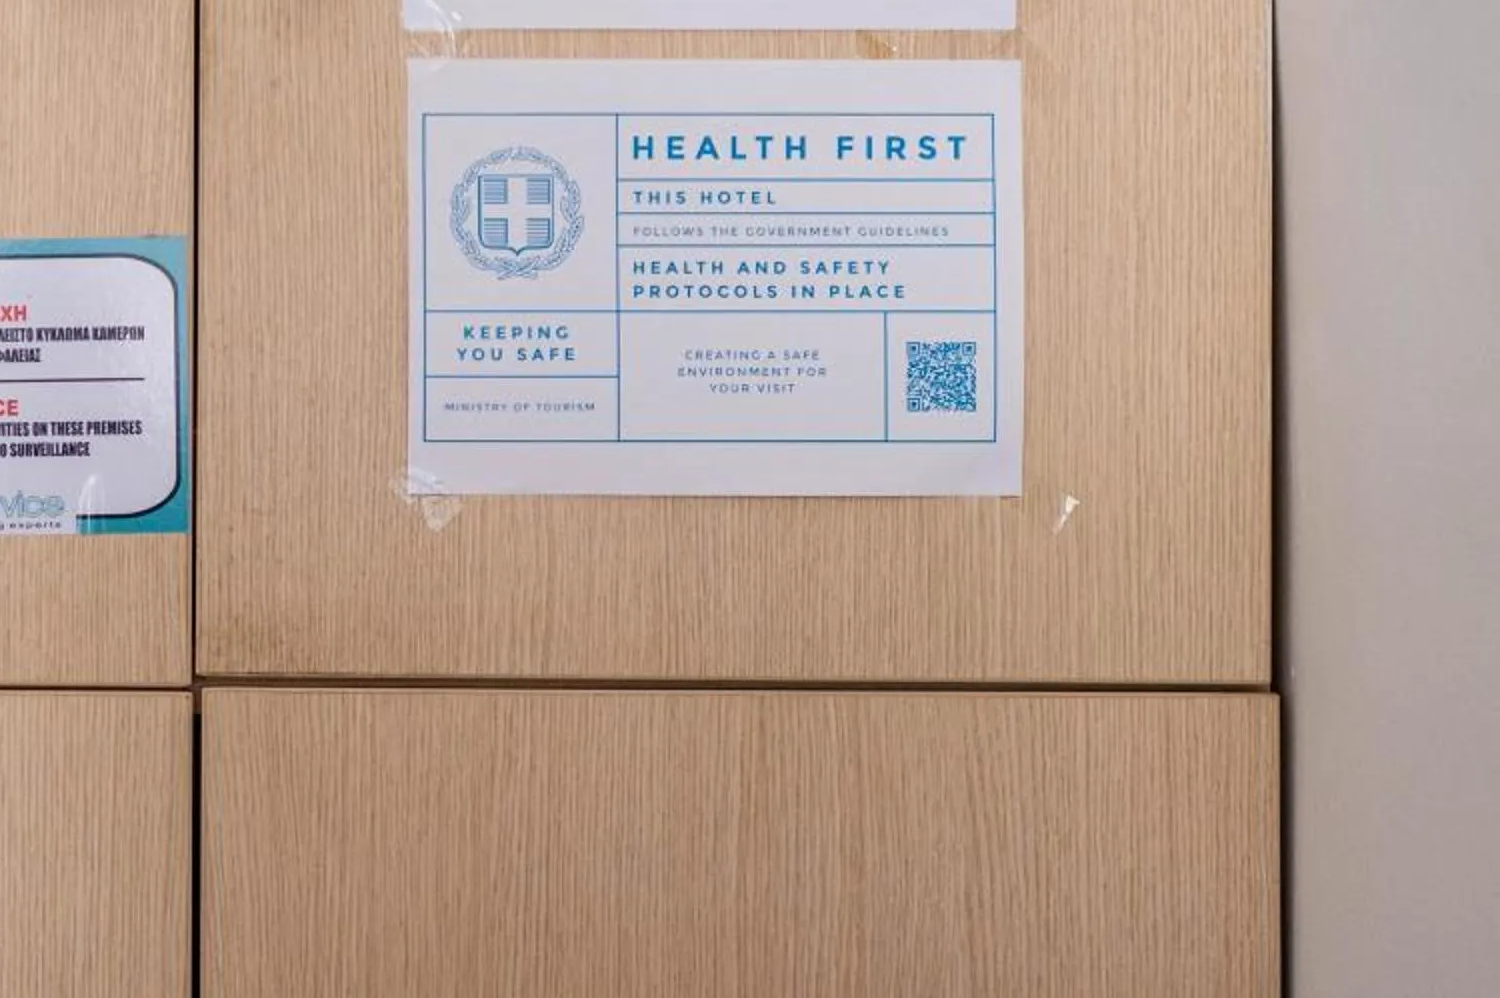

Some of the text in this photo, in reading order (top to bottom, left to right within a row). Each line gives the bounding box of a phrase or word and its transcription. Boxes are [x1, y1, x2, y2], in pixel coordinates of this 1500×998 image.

[632, 135, 967, 160] HEALTH FIRST
[633, 190, 777, 205] THIS HOTEL
[632, 225, 950, 238] FOLLOWS THE GOVERNMENT GUIDELINES
[632, 260, 890, 275] HEALTH AND SAFETY
[632, 284, 905, 299] PROTOCOLS IN PLACE
[463, 325, 569, 340] KEEPING
[456, 347, 577, 362] YOU SAFE
[683, 349, 821, 361] CREATING A SAFE
[677, 367, 827, 378] ENVIRONMENT FOR
[709, 383, 796, 394] YOUR VISIT
[443, 401, 596, 413] MINISTRY OF TOURISM
[32, 421, 48, 436] ON
[50, 420, 84, 436] THESE
[86, 420, 143, 435] PREMISES
[9, 441, 91, 458] SURVEILLANCE
